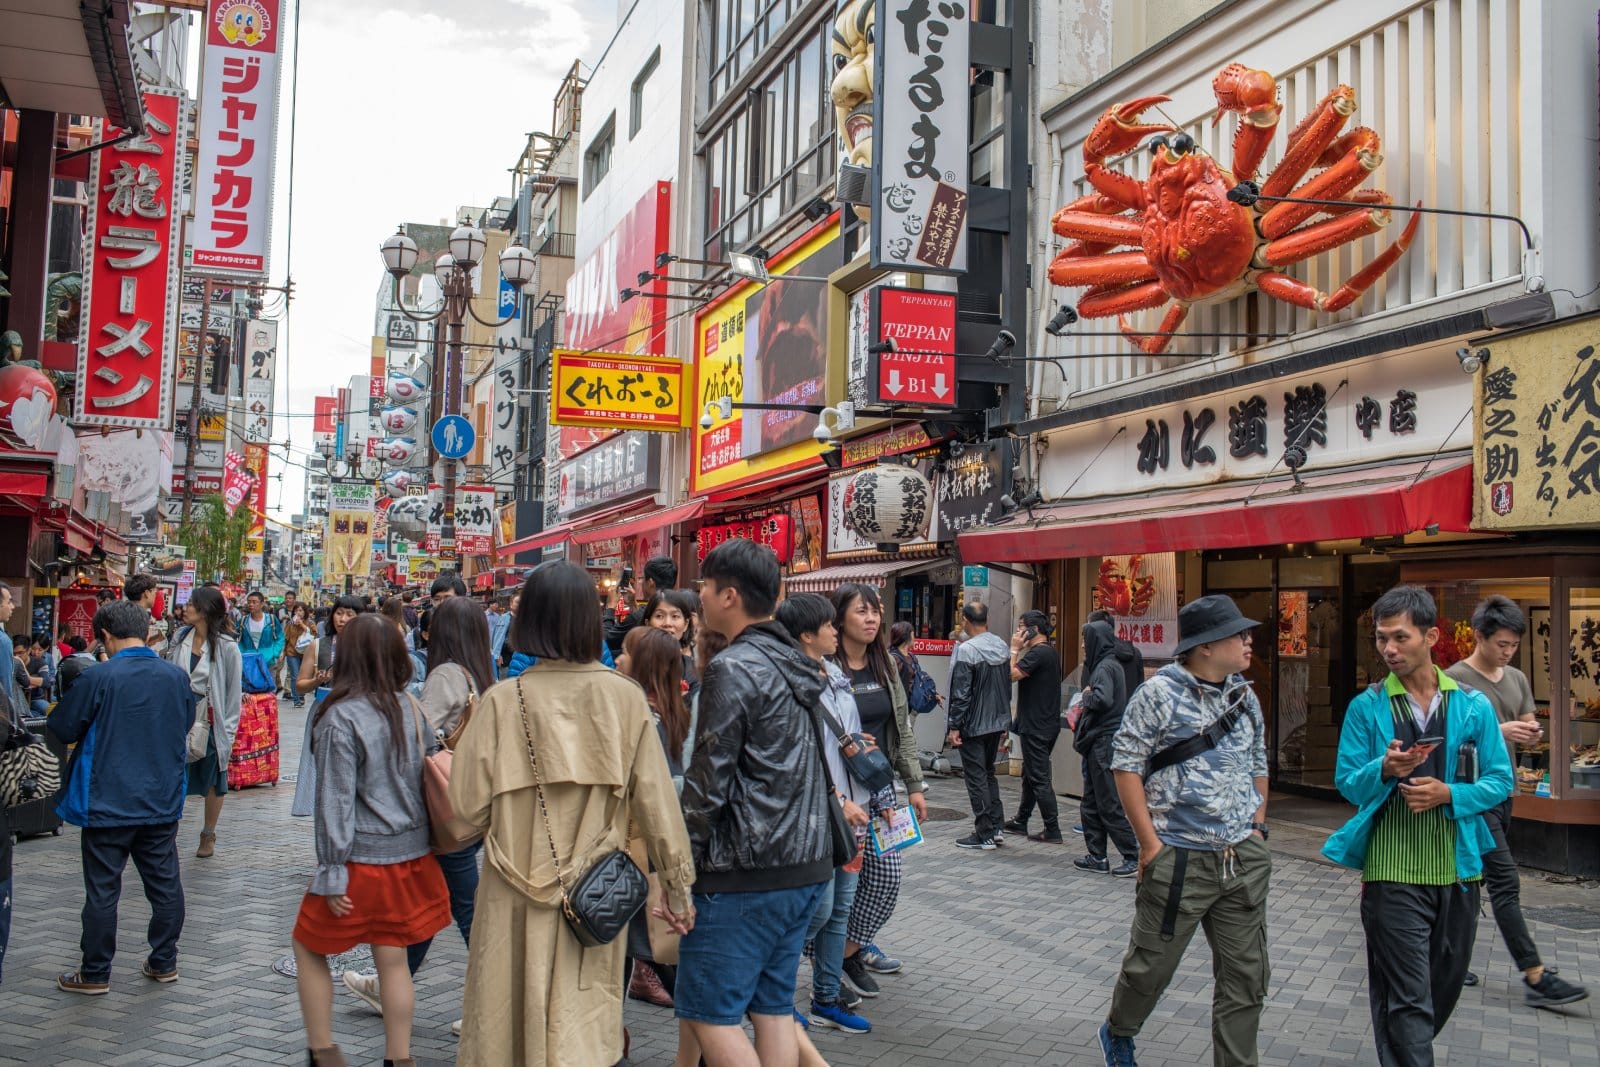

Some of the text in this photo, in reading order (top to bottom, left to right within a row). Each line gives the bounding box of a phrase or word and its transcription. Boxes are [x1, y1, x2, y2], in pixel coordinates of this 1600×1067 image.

[211, 56, 261, 249] ジャンカラ
[500, 290, 520, 309] 肉
[900, 295, 953, 308] TEPPANYAKI
[883, 322, 953, 342] TEPPAN
[882, 347, 945, 366] JINJYA
[565, 373, 674, 409] くれおーる
[908, 377, 928, 394] B1
[1483, 366, 1519, 486] 愛之助
[194, 480, 220, 489] INFO
[335, 498, 370, 506] EXPO2025
[891, 476, 928, 539] 鉄板神社
[912, 641, 926, 651] GO
[925, 642, 944, 652] down
